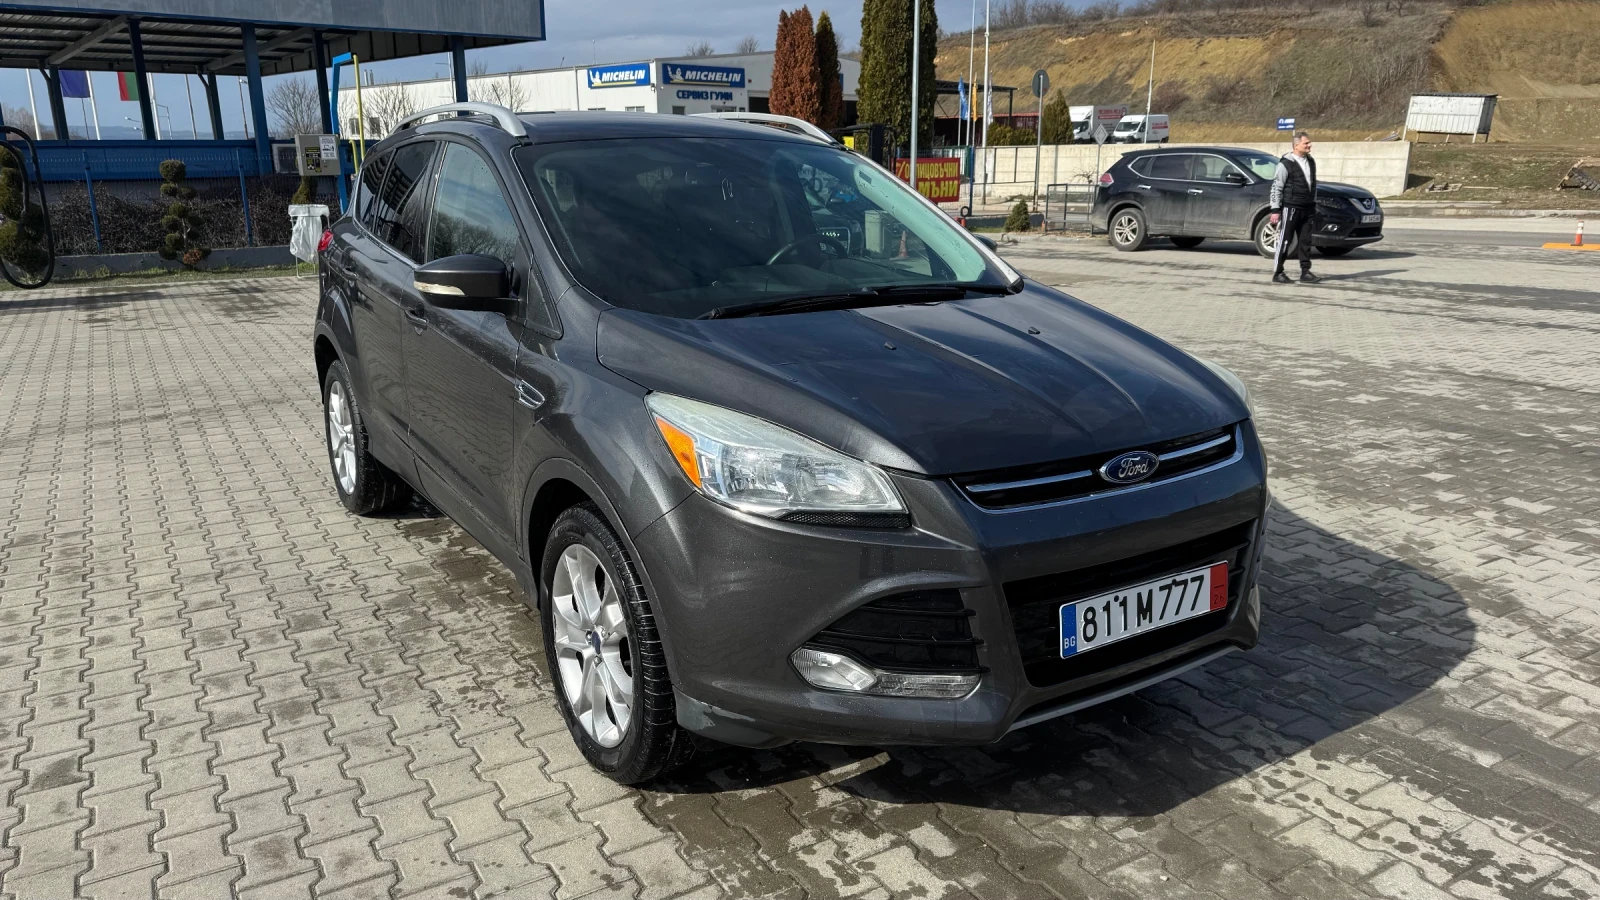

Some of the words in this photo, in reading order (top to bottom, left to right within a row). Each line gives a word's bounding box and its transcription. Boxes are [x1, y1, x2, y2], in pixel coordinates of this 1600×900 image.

[601, 69, 646, 82] MICHELIN
[685, 70, 741, 82] MICHELIN
[676, 89, 709, 100] СЕРВИЗ
[710, 90, 733, 101] ГУМИ
[1118, 456, 1149, 478] Ford
[1063, 636, 1076, 650] BG
